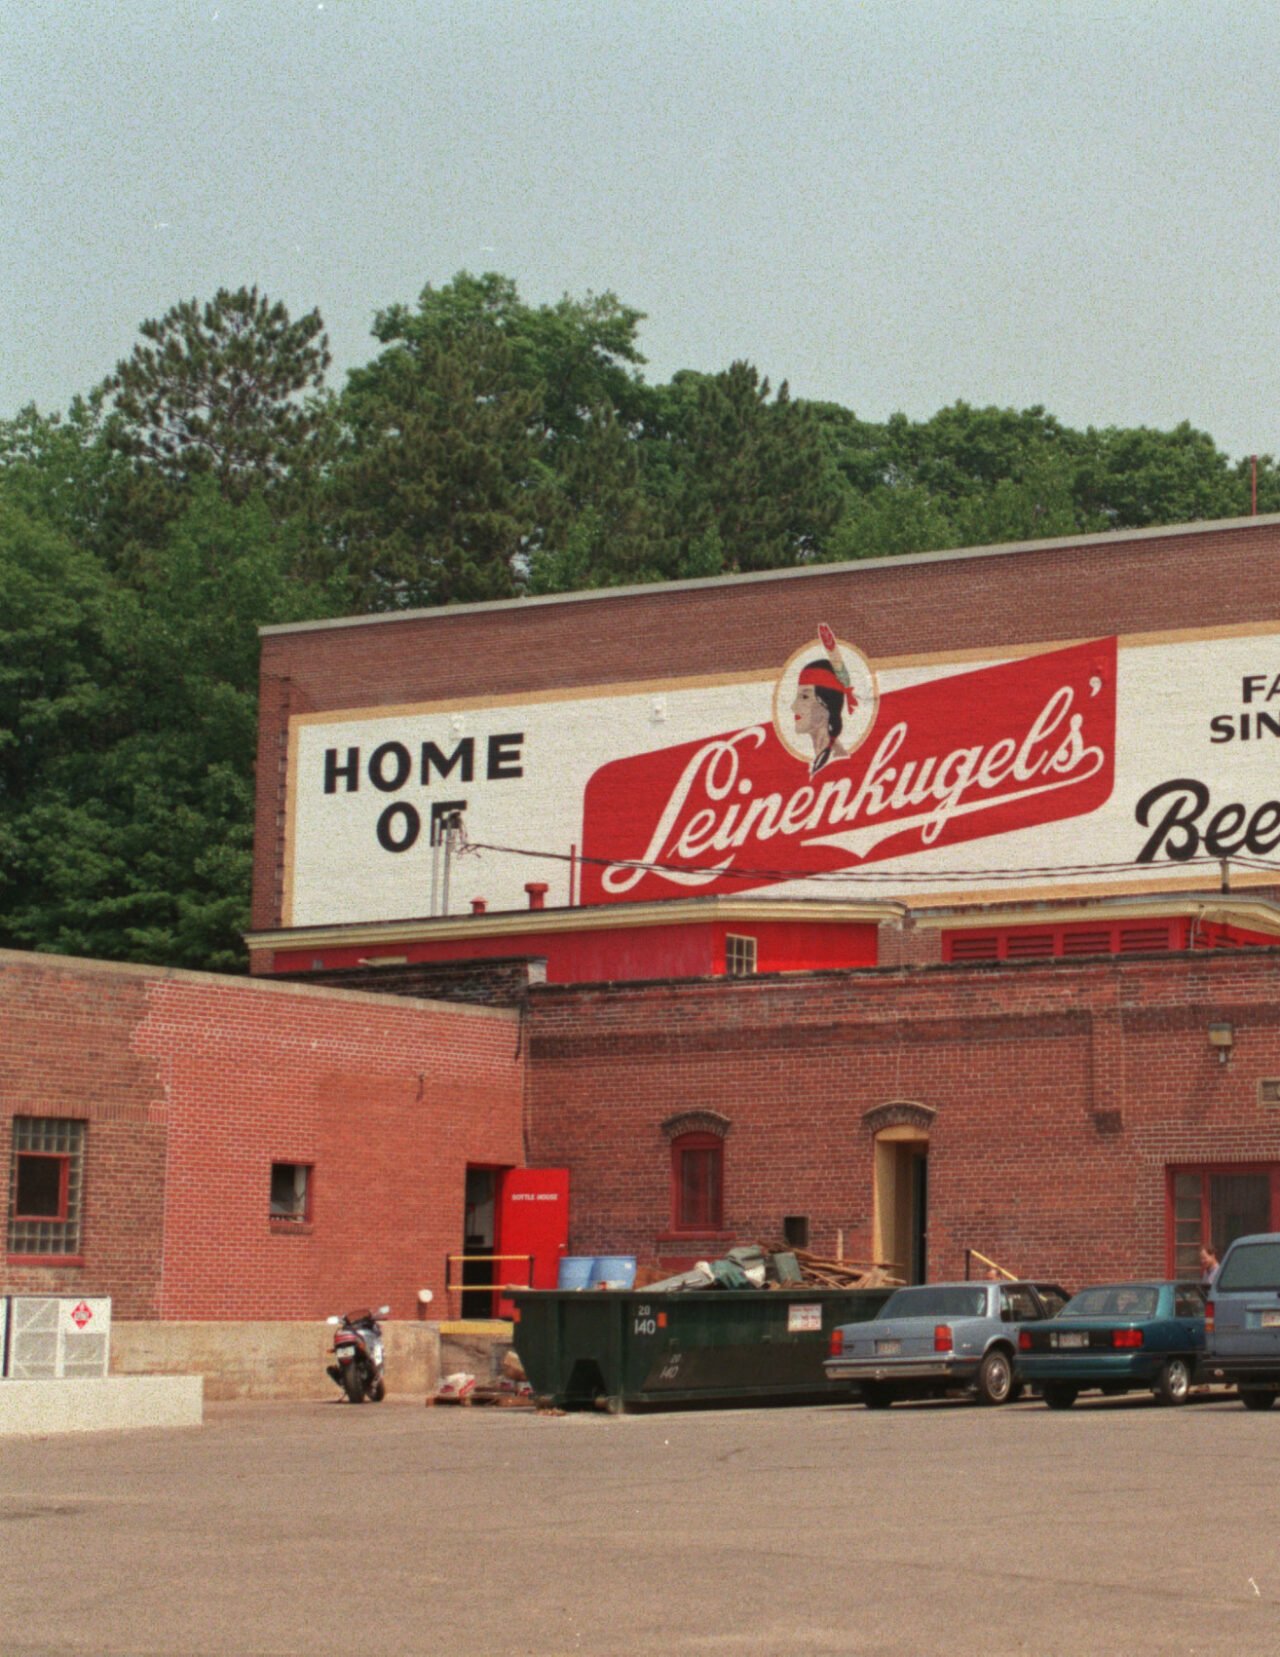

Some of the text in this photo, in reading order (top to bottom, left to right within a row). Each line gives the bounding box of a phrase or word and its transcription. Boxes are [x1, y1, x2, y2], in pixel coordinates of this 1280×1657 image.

[323, 732, 525, 795] HOME
[376, 799, 468, 854] OF
[634, 1319, 656, 1335] 140
